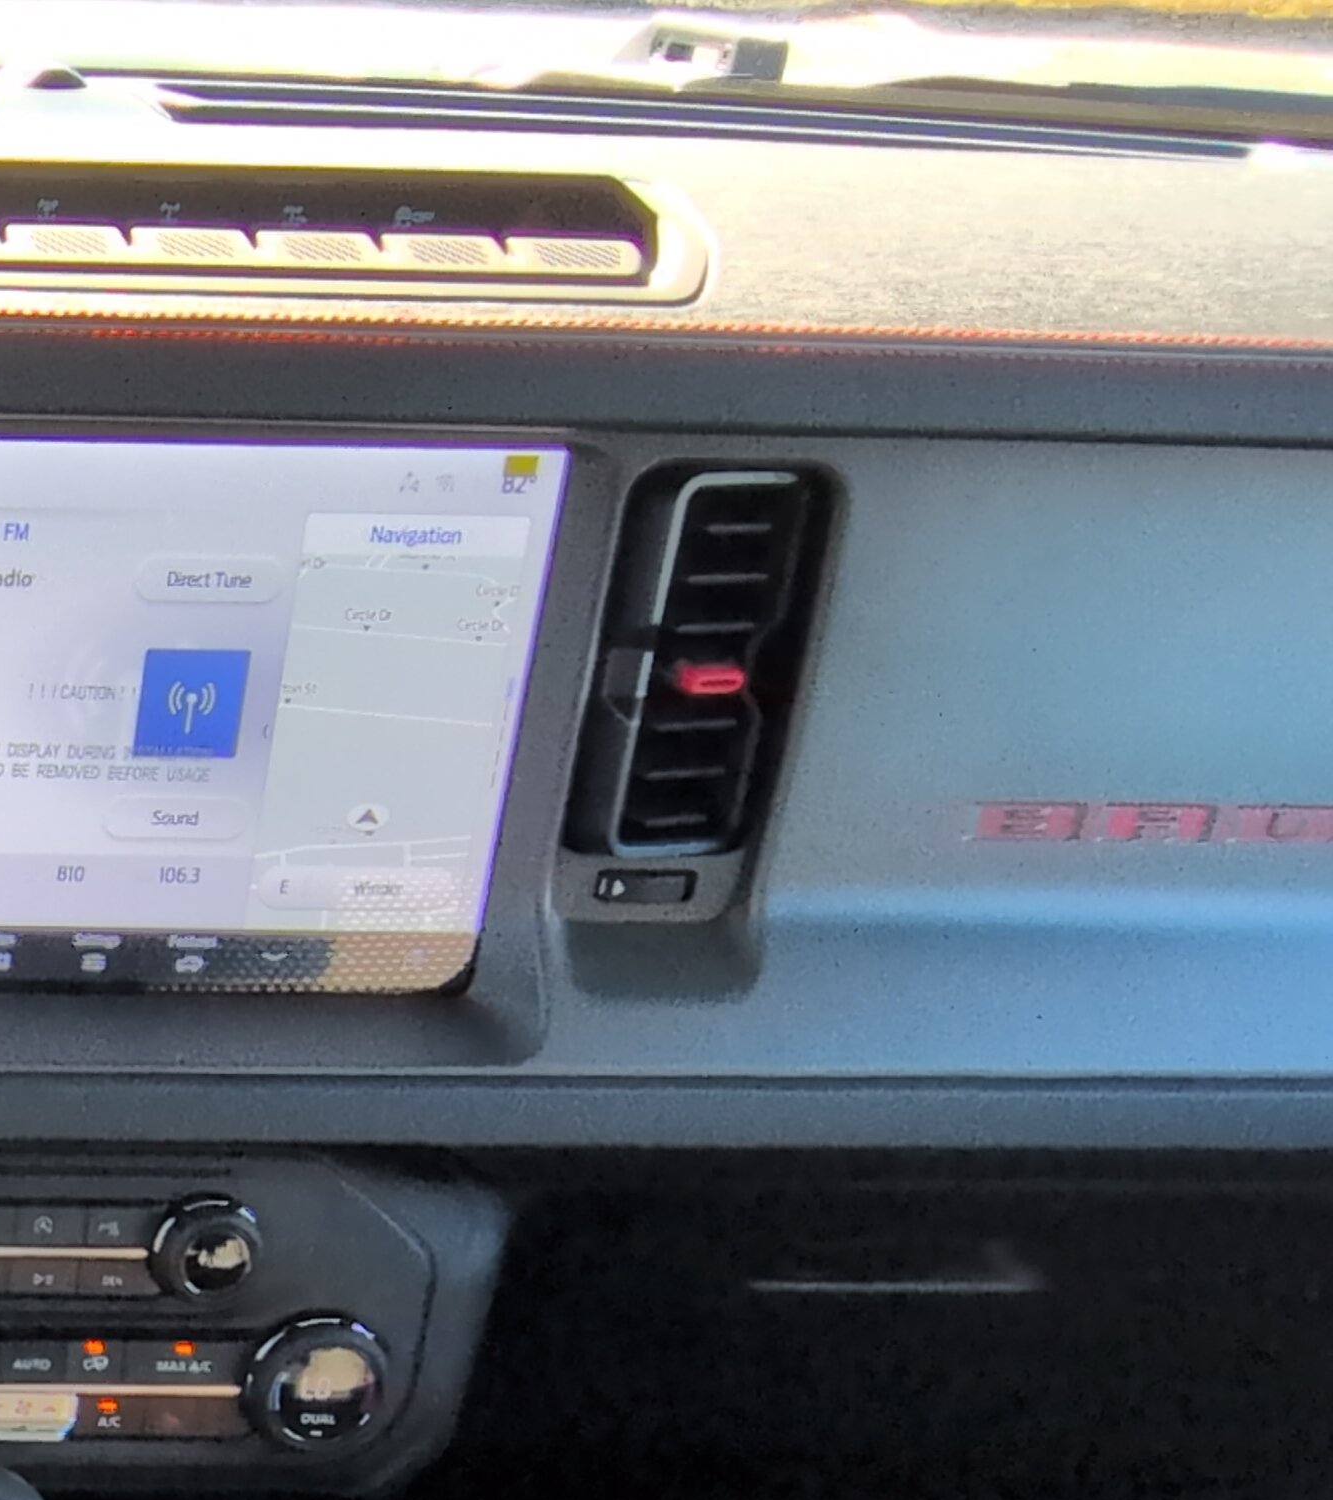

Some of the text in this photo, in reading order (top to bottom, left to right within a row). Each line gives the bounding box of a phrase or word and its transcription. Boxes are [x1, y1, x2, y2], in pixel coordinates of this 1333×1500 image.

[3, 522, 30, 541] FM
[369, 525, 462, 546] Navigation
[166, 572, 253, 589] Direct Tune
[8, 742, 61, 758] DISPLAY
[67, 744, 116, 759] DURING
[11, 763, 30, 778] BE
[37, 765, 100, 779] REMOVED
[107, 766, 159, 781] BEFORE
[167, 767, 213, 782] USAGE
[152, 809, 200, 826] Sound
[56, 866, 85, 883] 810
[159, 867, 202, 884] 106.3
[279, 879, 290, 895] E
[12, 1357, 51, 1371] AUTO
[97, 1415, 121, 1429] A/C
[300, 1413, 336, 1425] DUAL
